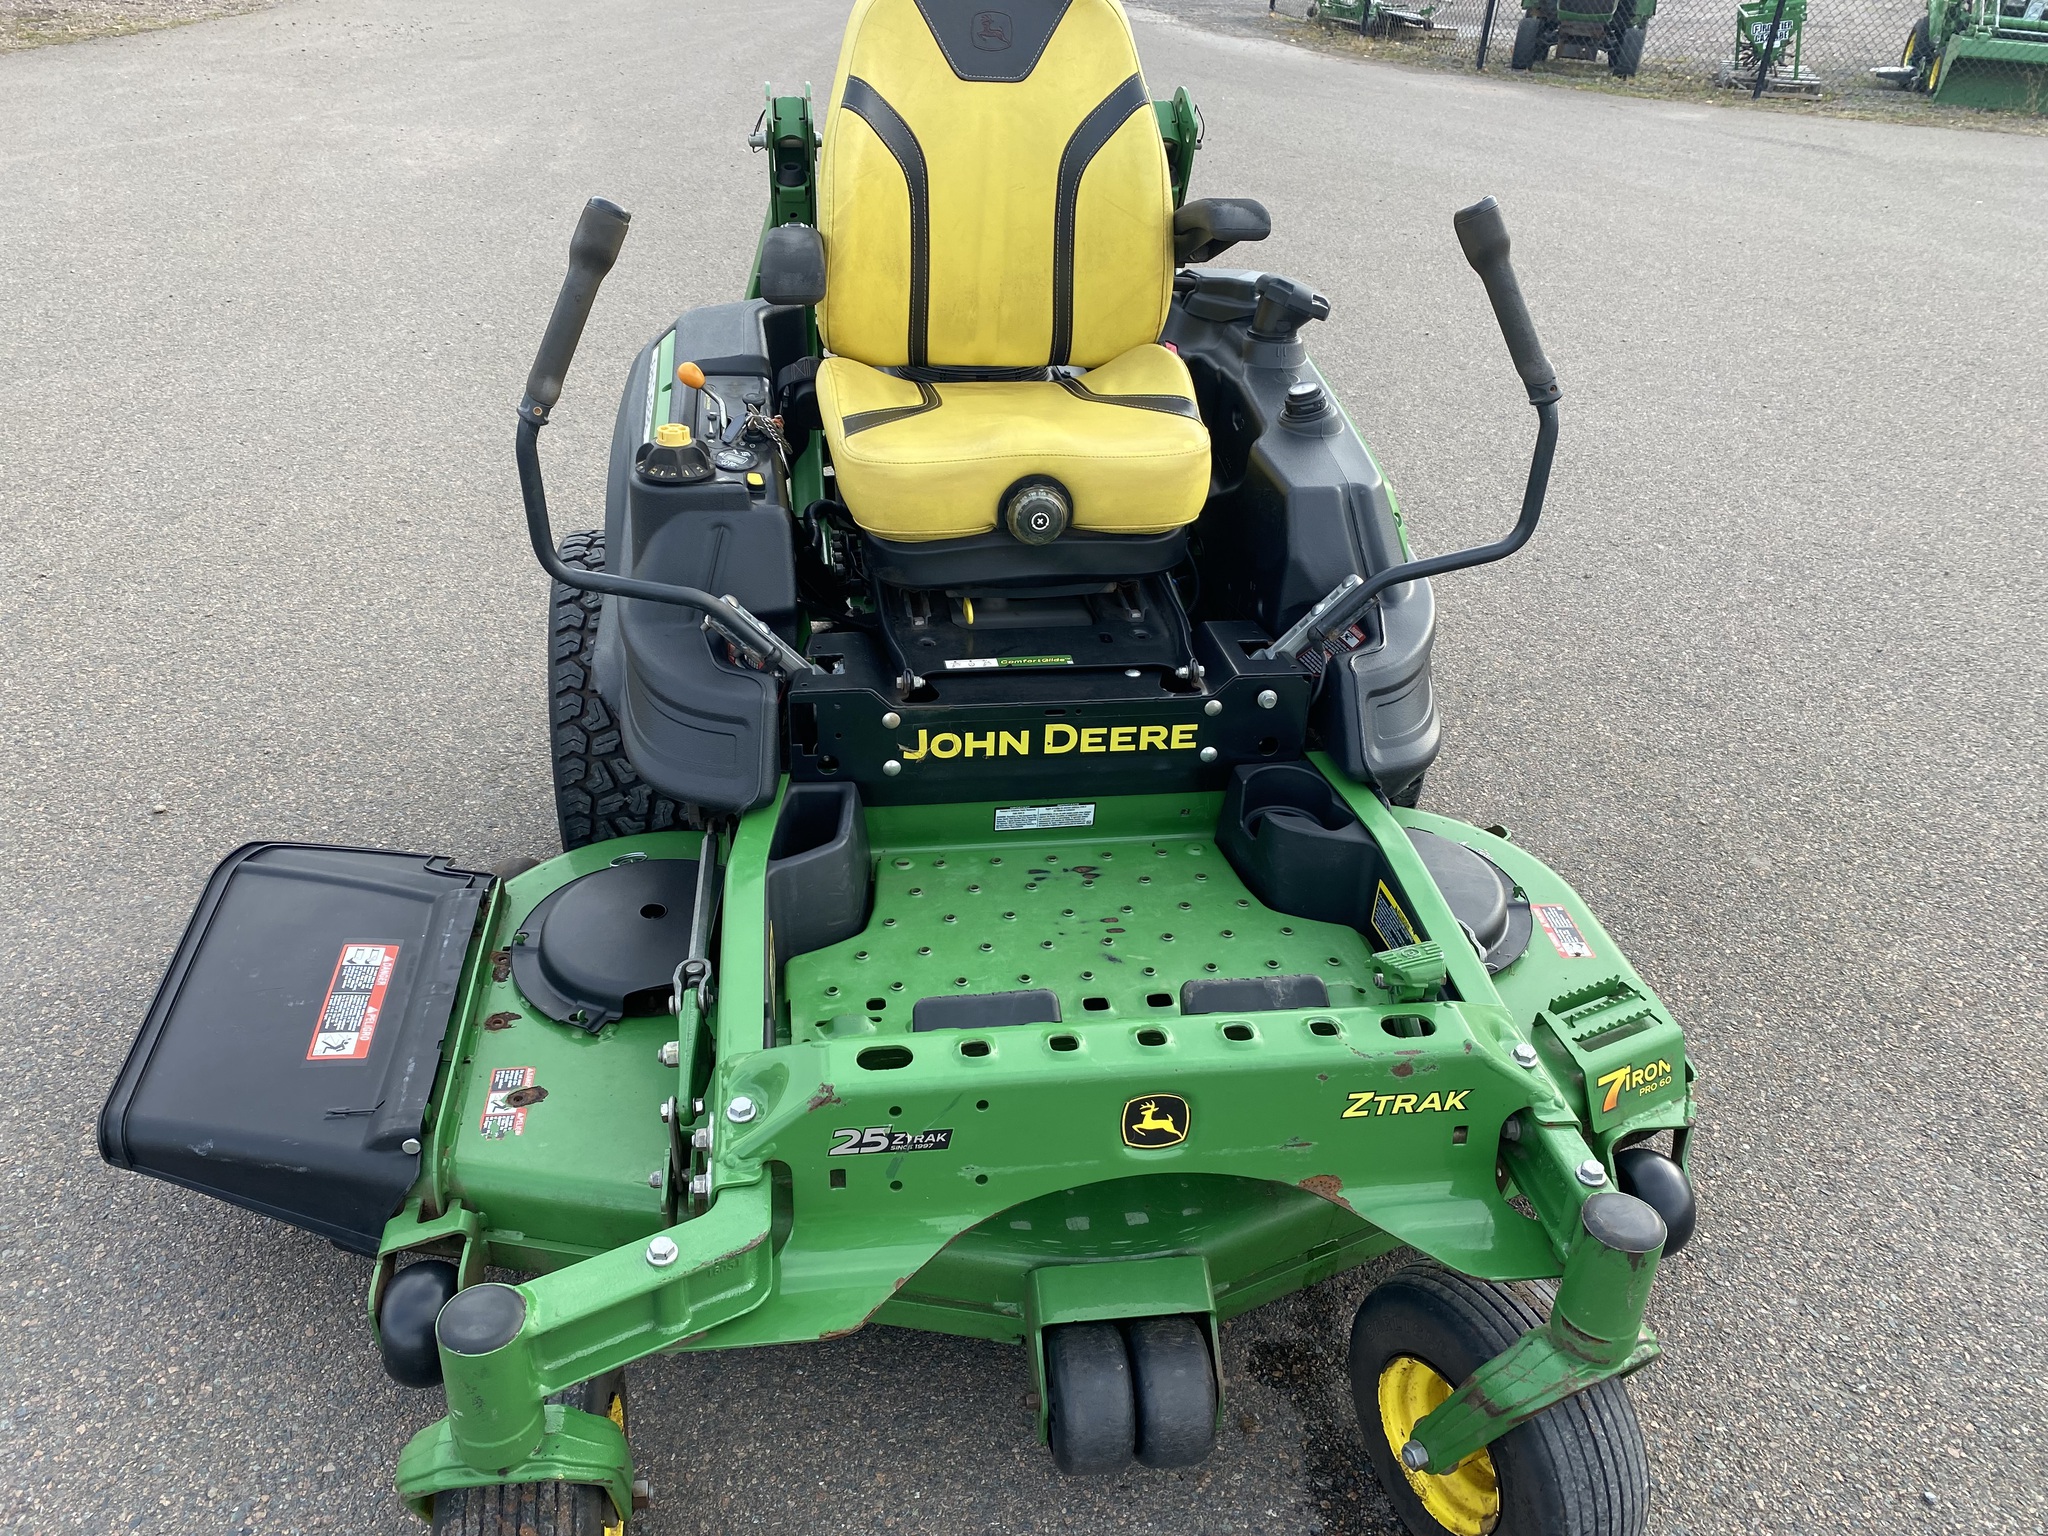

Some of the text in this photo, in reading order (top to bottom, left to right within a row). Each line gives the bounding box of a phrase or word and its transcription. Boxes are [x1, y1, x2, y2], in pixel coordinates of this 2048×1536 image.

[1752, 20, 1793, 35] FROIER
[903, 723, 1198, 760] JOHN DEERE
[377, 962, 394, 986] DANGER
[360, 1013, 379, 1041] PELIGRO
[1625, 1059, 1671, 1092] IRON
[1639, 1075, 1673, 1097] PRO 60
[1341, 1090, 1475, 1119] ZTRAK
[829, 1127, 890, 1155] 25
